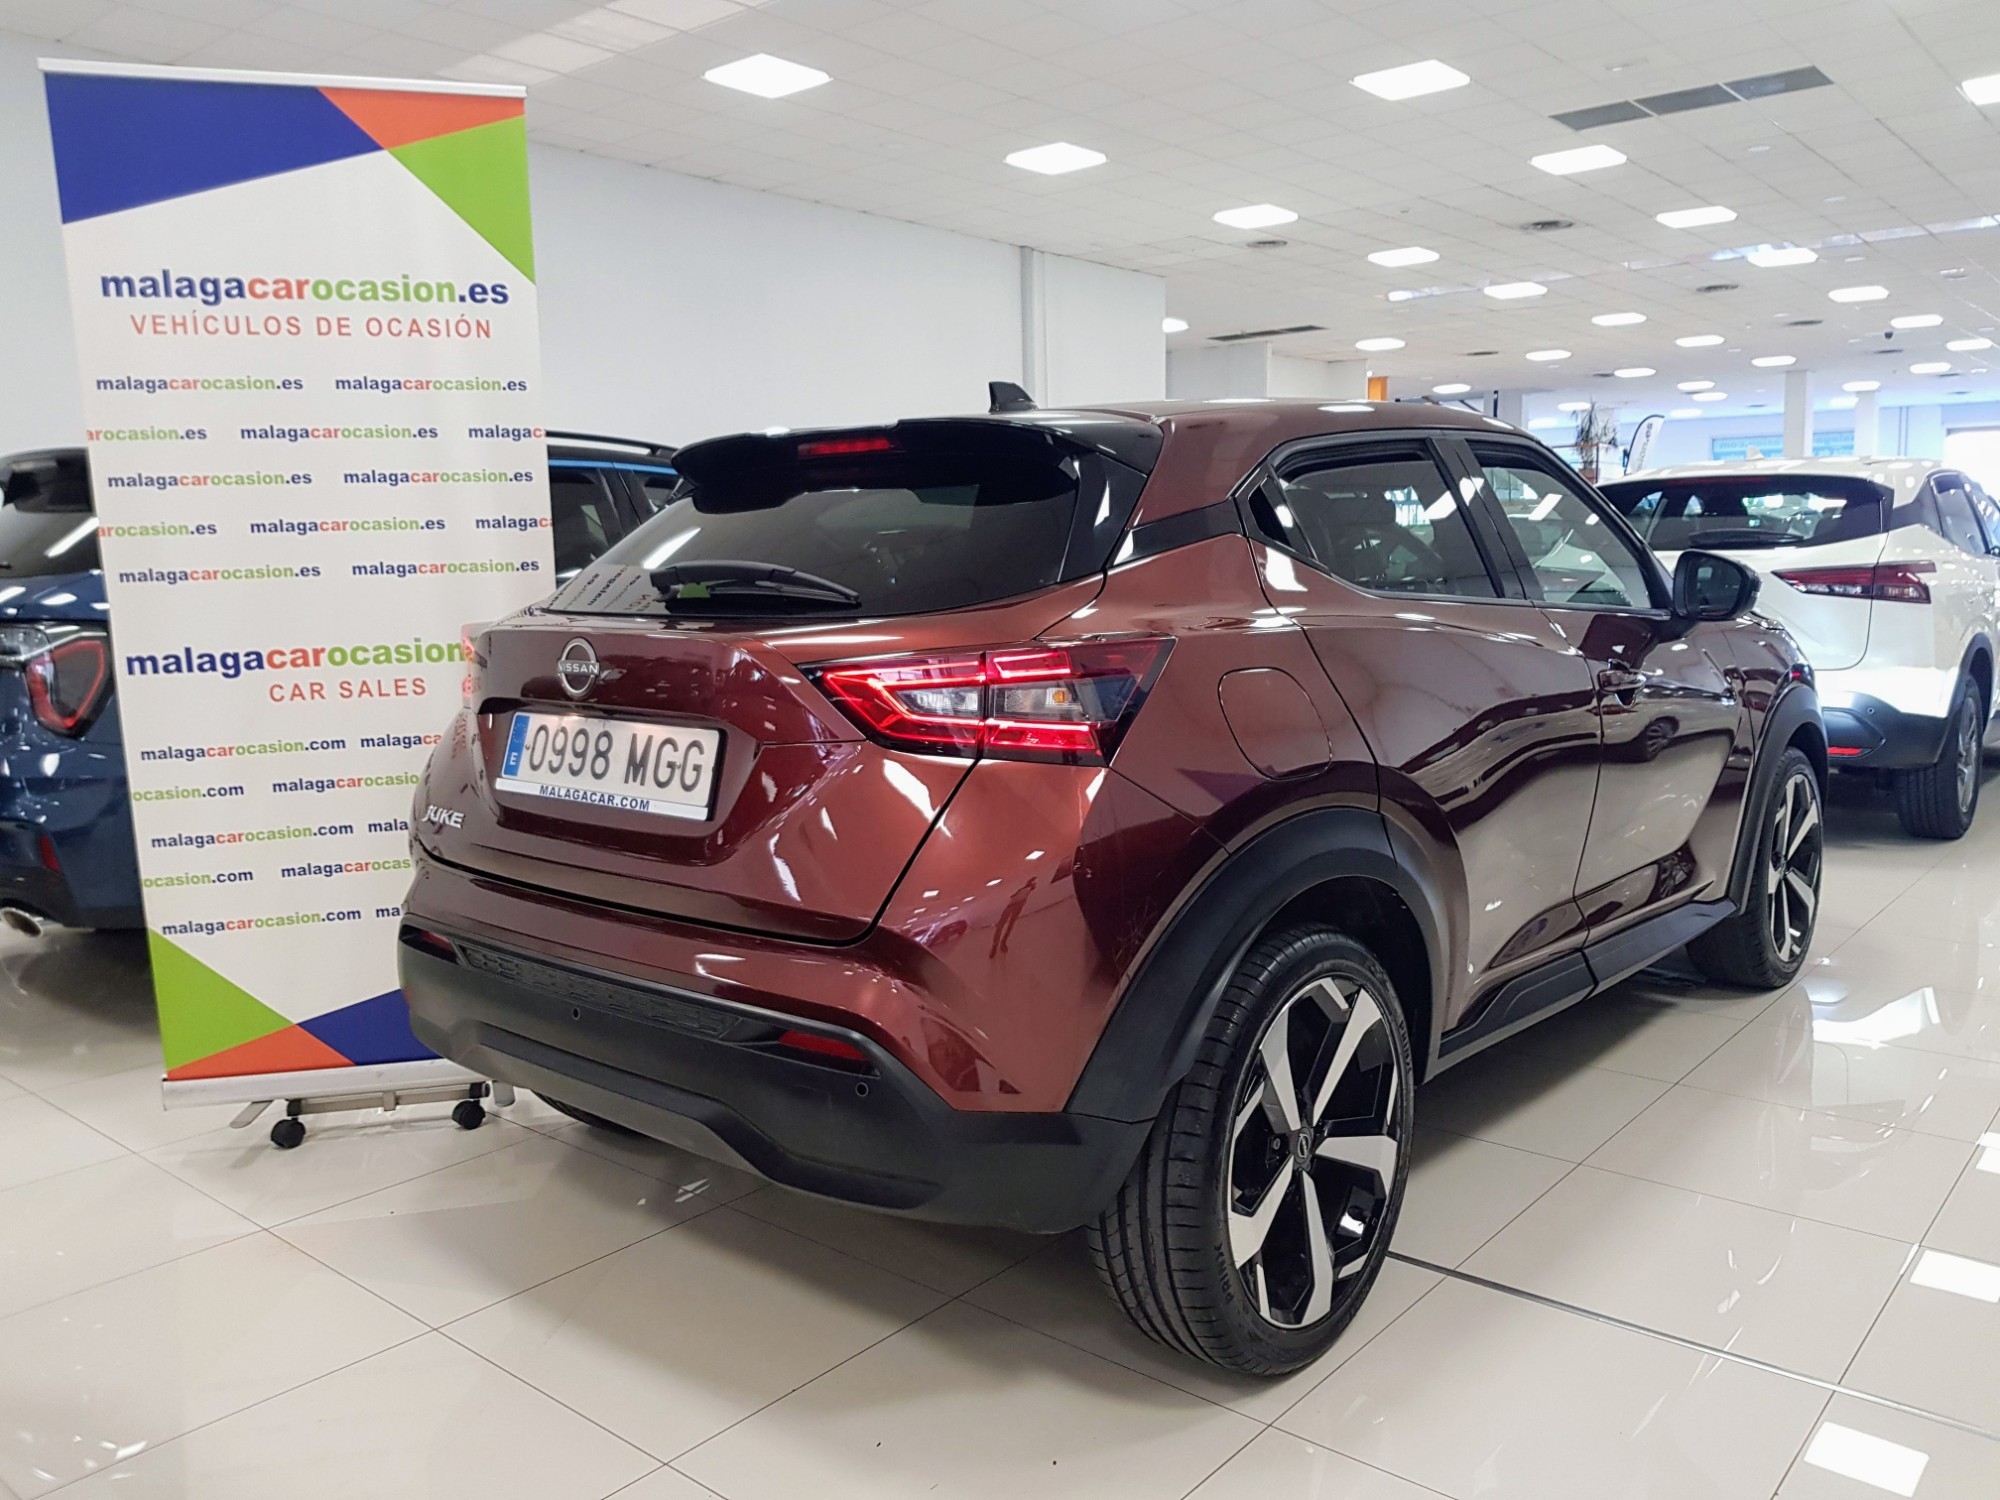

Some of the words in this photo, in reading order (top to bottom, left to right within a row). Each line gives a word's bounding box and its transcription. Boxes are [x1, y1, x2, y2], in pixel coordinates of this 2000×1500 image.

[101, 269, 509, 306] malagacarocasion.es
[131, 310, 300, 335] VEHÍCULOS
[316, 317, 351, 336] DE
[366, 314, 490, 338] OCASIÓN
[96, 376, 303, 393] malagacarocasion.es
[336, 376, 527, 393] malagacarocasion.es
[241, 425, 438, 442] malagacarocasion.es
[469, 424, 546, 442] malagac
[108, 471, 312, 490] malagacarocasion.es
[344, 469, 533, 486] malagacarocasion.es
[250, 517, 445, 536] malagacarocasion.es
[476, 513, 552, 531] malagac
[119, 565, 321, 585] malagacarocasion.es
[352, 560, 539, 578] malagacarocasion.es
[557, 662, 599, 674] NISSAN
[270, 682, 325, 702] CAR
[339, 678, 425, 698] SALES
[141, 739, 346, 761] malagacarocasion.com
[509, 752, 518, 766] E
[529, 724, 614, 780] 0998
[624, 733, 705, 792] MGG
[132, 784, 245, 802] ocasion.com
[539, 785, 650, 811] MALAGACAR.COM
[422, 804, 465, 829] JUKE
[151, 825, 354, 848] malagacarocasion.com
[143, 869, 254, 889] ocasion.com
[162, 909, 361, 937] malagacarocasion.com
